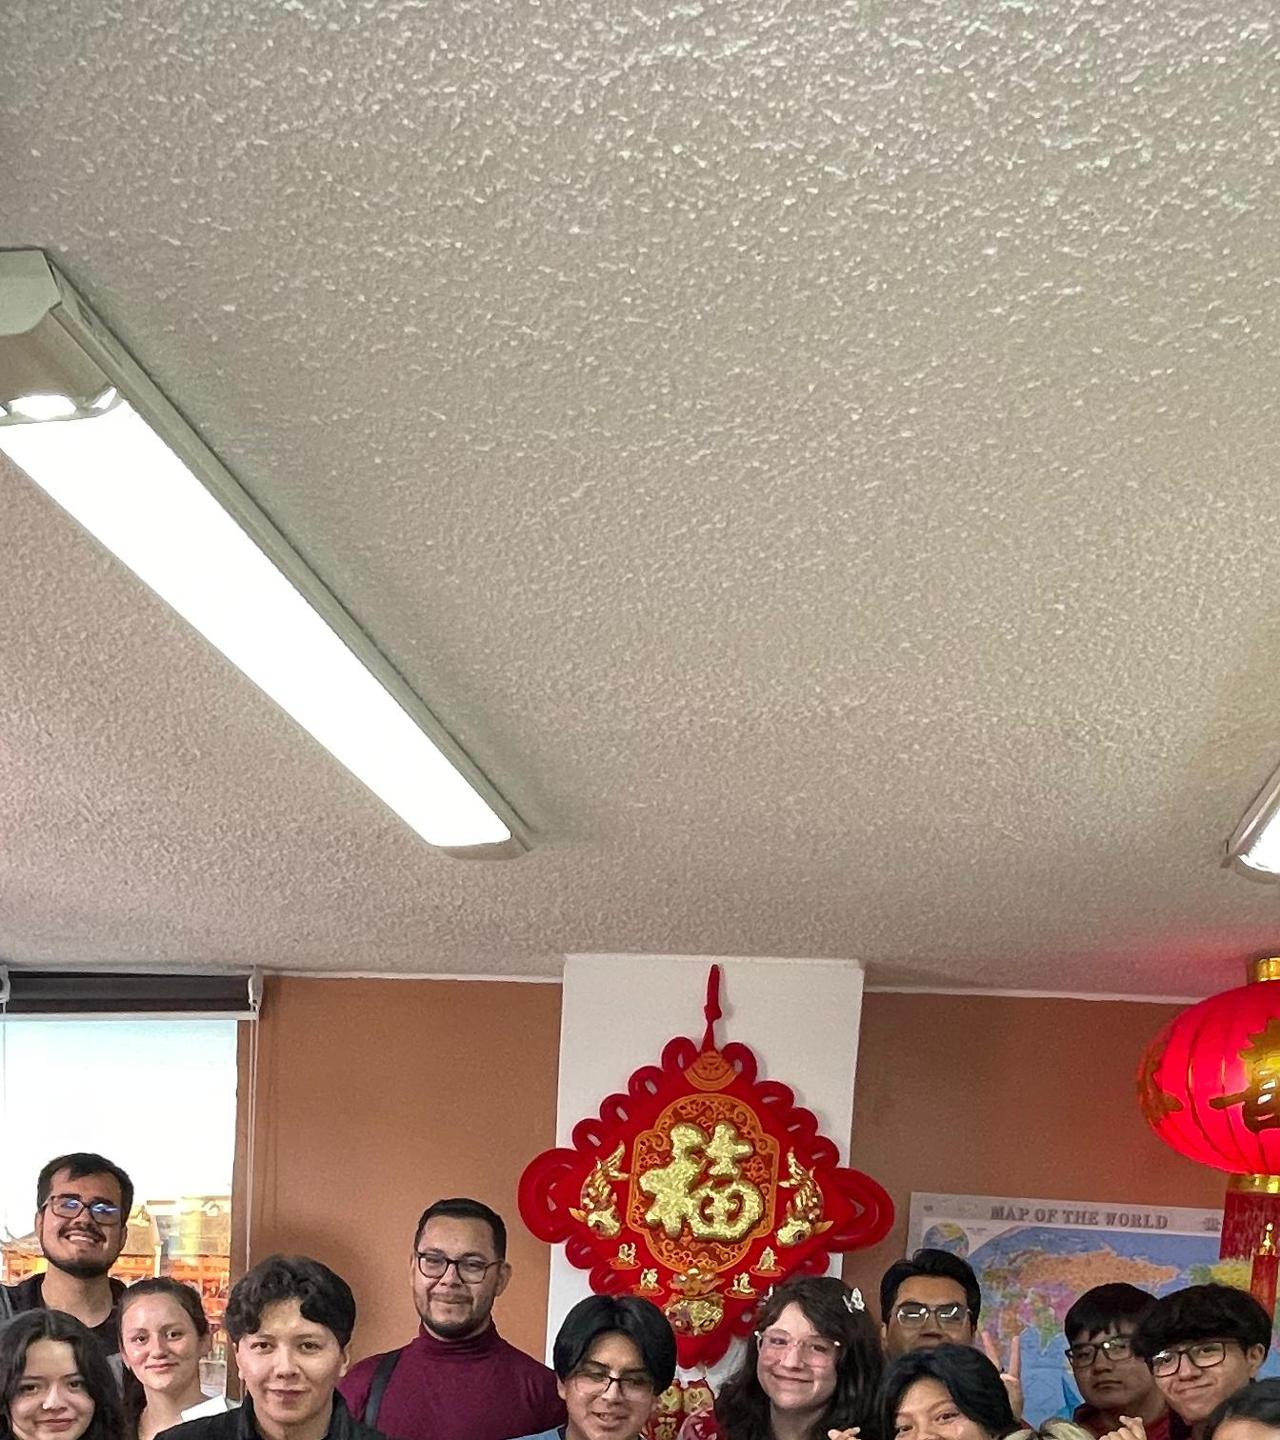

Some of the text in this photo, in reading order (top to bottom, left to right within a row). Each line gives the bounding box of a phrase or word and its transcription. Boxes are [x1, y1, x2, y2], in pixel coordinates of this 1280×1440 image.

[639, 1121, 765, 1242] 福
[990, 1205, 1169, 1230] MAP OF THE WORLD
